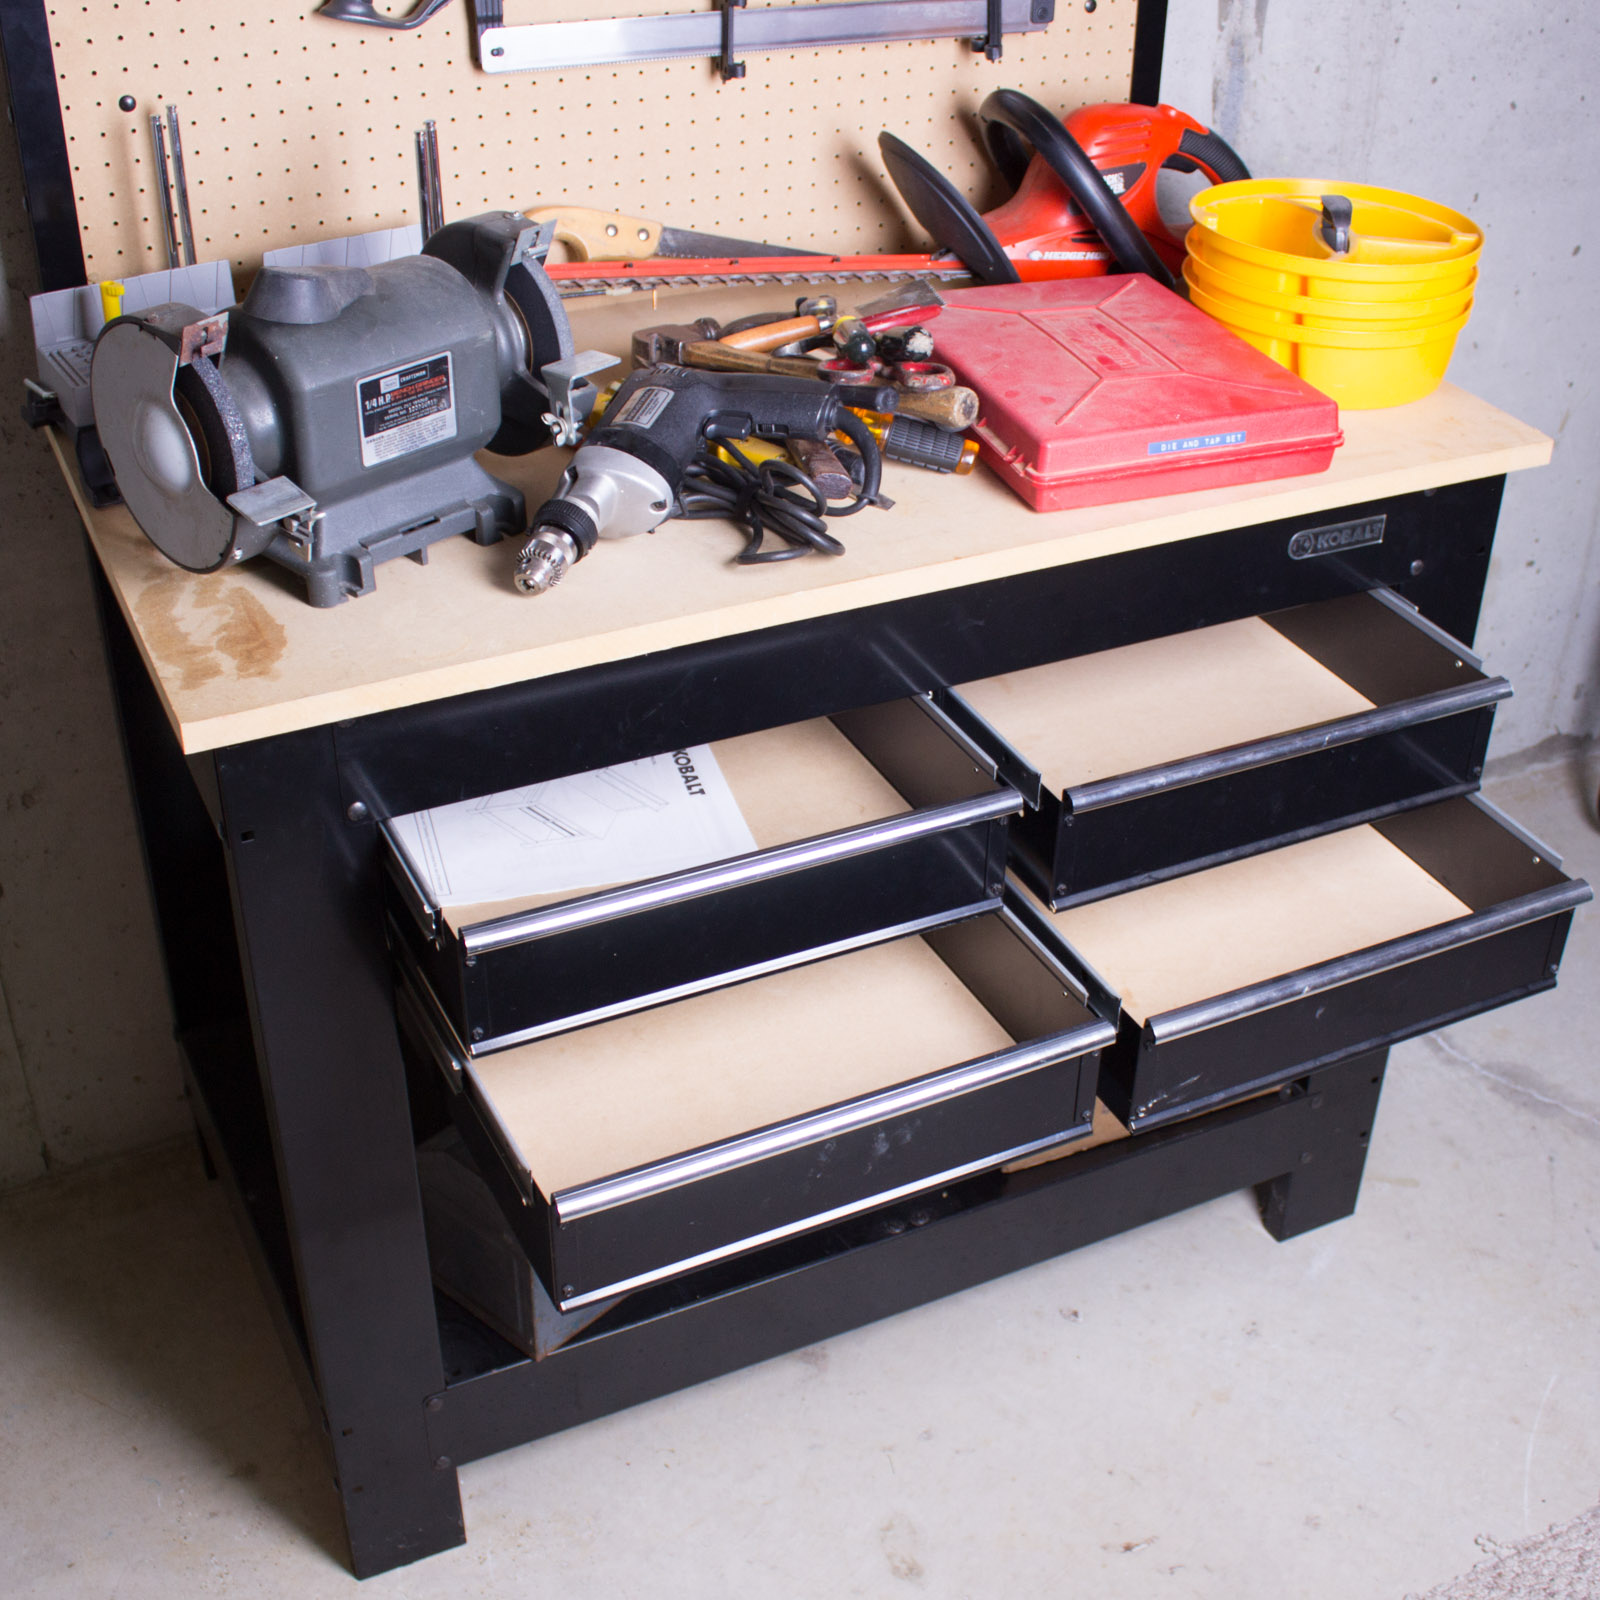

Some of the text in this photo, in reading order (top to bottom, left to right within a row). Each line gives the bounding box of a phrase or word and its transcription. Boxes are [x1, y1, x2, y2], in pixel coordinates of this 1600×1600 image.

[1160, 433, 1242, 452] DIE AND TAP SET
[1317, 523, 1382, 549] KOBALT
[672, 748, 706, 795] KOBALT
